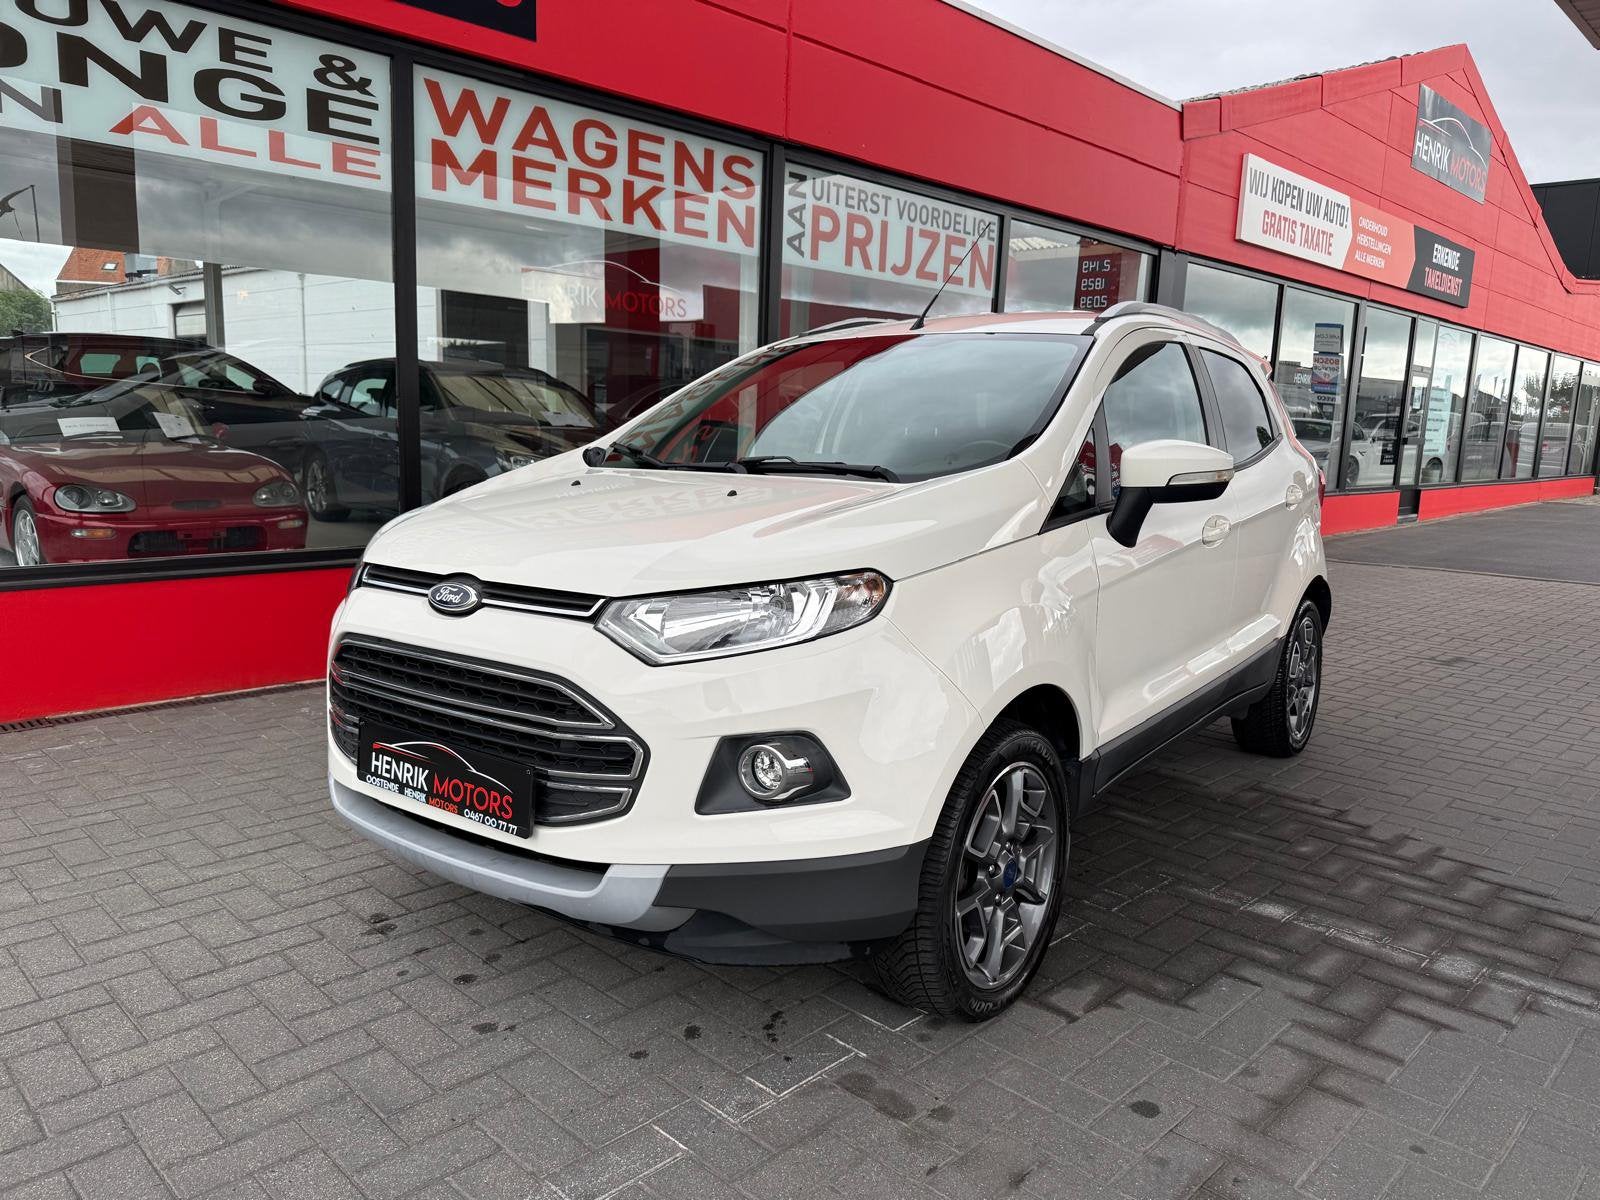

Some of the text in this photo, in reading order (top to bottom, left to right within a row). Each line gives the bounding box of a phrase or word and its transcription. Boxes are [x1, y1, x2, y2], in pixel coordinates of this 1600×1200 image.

[313, 54, 376, 97] &
[109, 104, 381, 180] ALLE
[423, 77, 756, 200] WAGENS
[1414, 130, 1487, 194] HENRIK MOTORS
[431, 139, 755, 249] MERKEN
[786, 171, 807, 258] AAN
[812, 177, 996, 242] UITERST VOORDELIGE
[1249, 167, 1349, 229] WIJ KOPEN UW AUTO!
[810, 204, 994, 291] PRIJZEN
[1262, 209, 1334, 256] GRATIS TAXATIE
[1432, 243, 1461, 271] ERKENDE
[521, 276, 687, 318] HERIK MOTORS
[436, 586, 464, 603] Ford
[366, 774, 400, 793] OOSTENDE
[404, 787, 427, 804] HENRIK
[429, 796, 458, 814] MOTORS
[463, 808, 484, 823] 0467
[371, 751, 513, 820] HENRIK MOTORS
